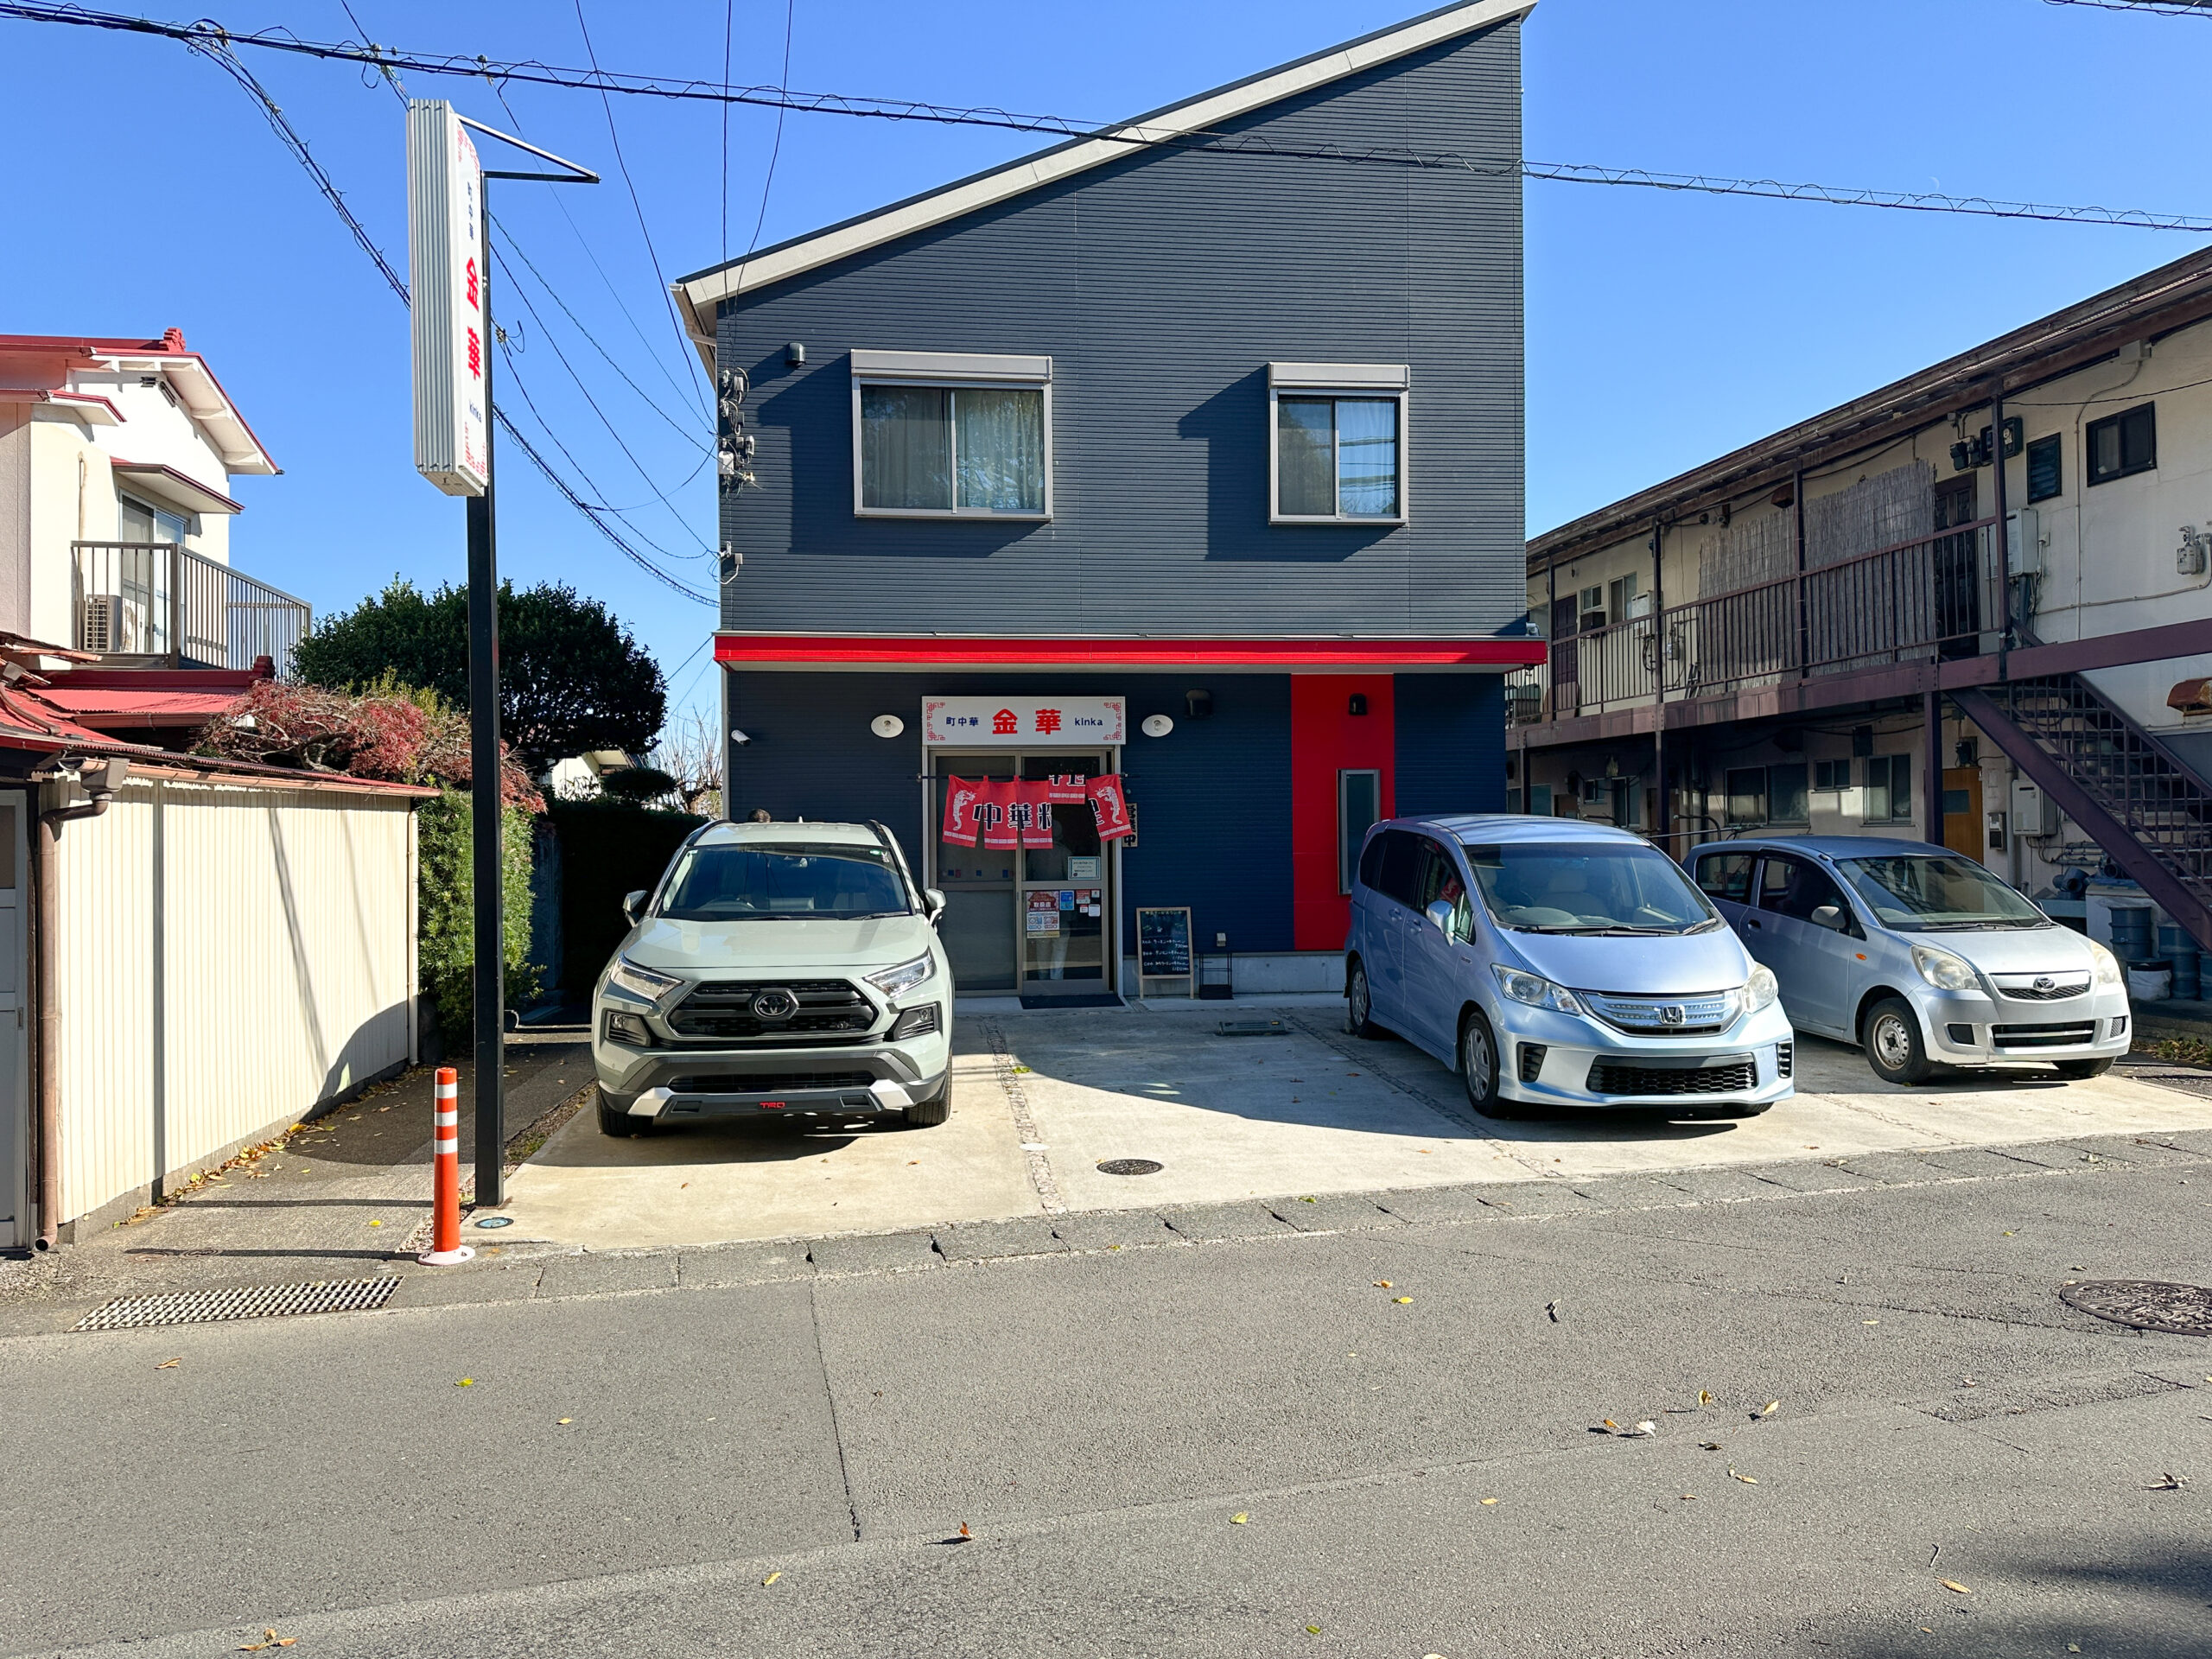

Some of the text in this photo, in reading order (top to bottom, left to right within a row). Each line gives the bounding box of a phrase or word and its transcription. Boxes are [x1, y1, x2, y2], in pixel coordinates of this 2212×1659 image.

[467, 257, 481, 379] 金華
[946, 709, 1061, 734] 町中華 金華
